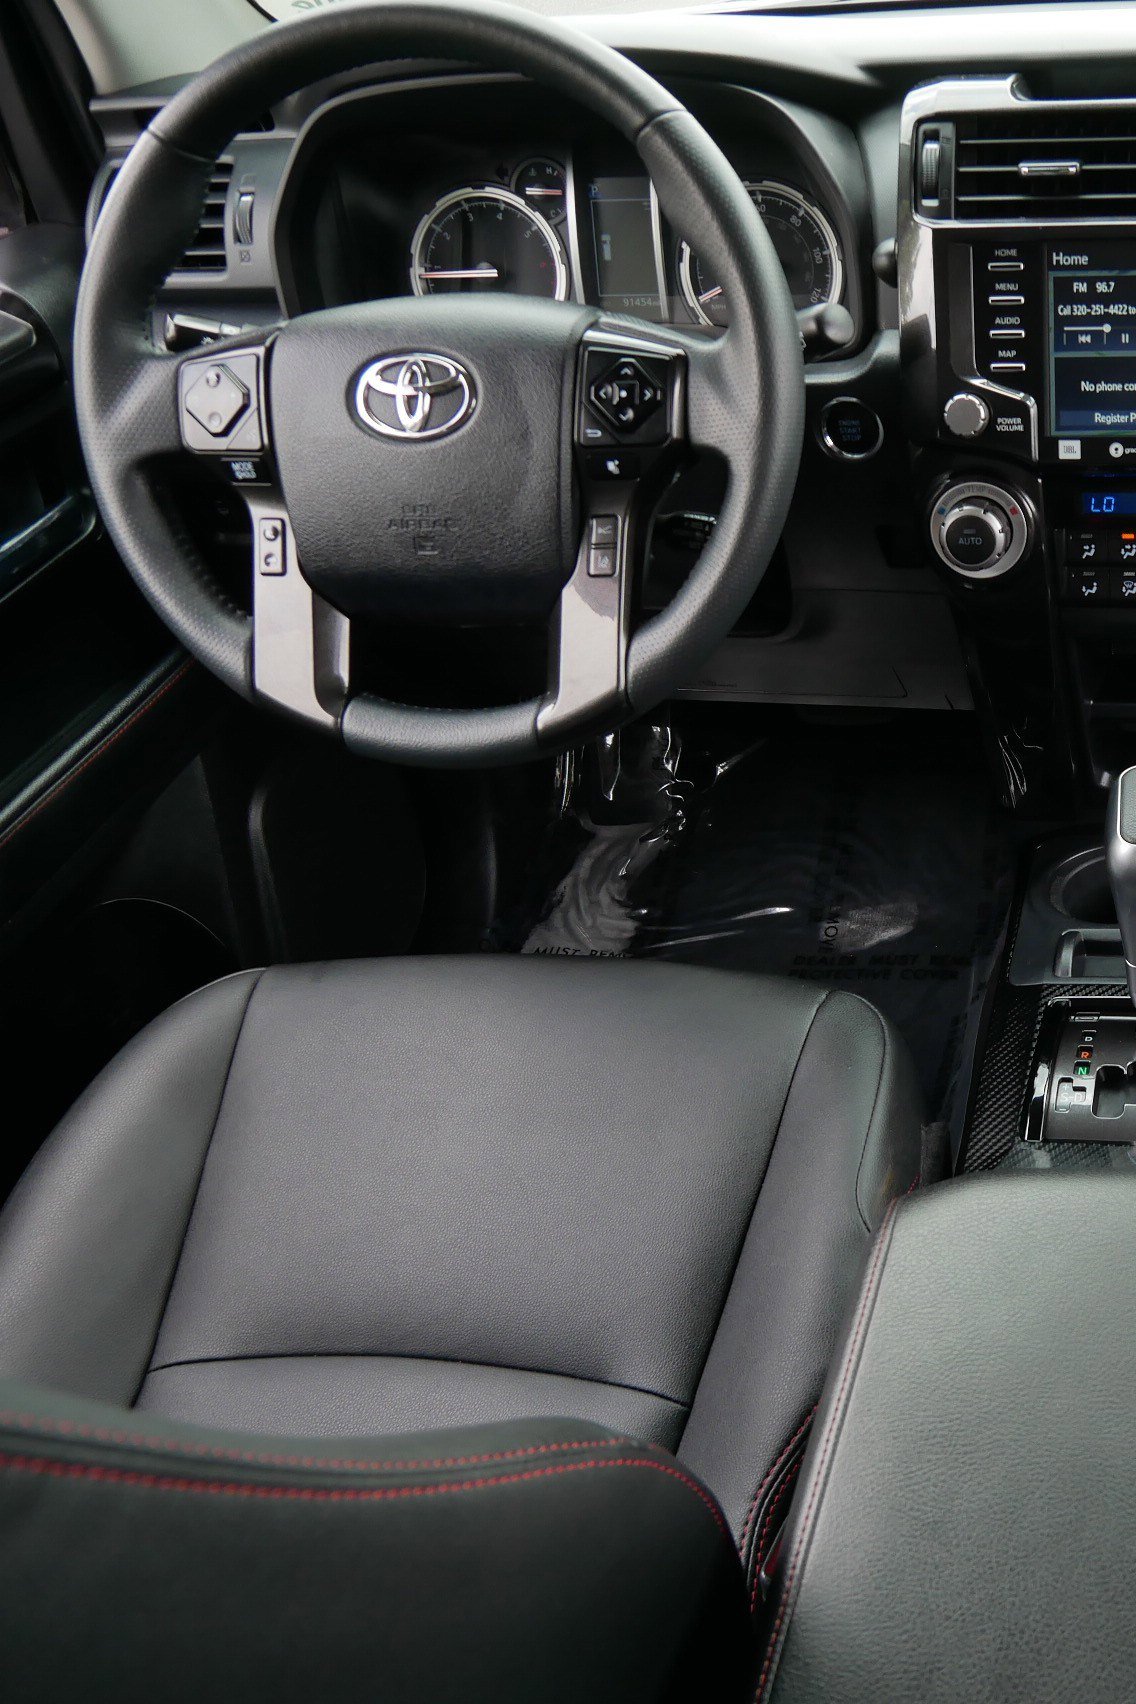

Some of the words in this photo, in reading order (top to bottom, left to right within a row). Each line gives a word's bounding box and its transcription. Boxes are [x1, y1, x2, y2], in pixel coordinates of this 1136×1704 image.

[789, 214, 803, 228] 80
[812, 247, 824, 265] 100
[994, 249, 1018, 257] HOME
[1052, 252, 1089, 267] Home
[995, 283, 1019, 291] MENU
[1073, 282, 1088, 293] FM
[1095, 281, 1115, 293] 96.7
[1058, 305, 1072, 316] Call
[1072, 304, 1128, 315] 320-251-4422
[1128, 305, 1136, 315] to
[994, 317, 1021, 325] AUDIO
[998, 350, 1017, 358] MAP
[1081, 381, 1095, 392] No
[1096, 381, 1123, 394] phone
[997, 417, 1022, 425] POWER
[1094, 412, 1129, 426] Register
[996, 424, 1024, 432] VOLUME
[1090, 496, 1115, 512] LO
[958, 537, 982, 546] AUTO
[1080, 1051, 1089, 1059] R
[1077, 1066, 1087, 1075] N
